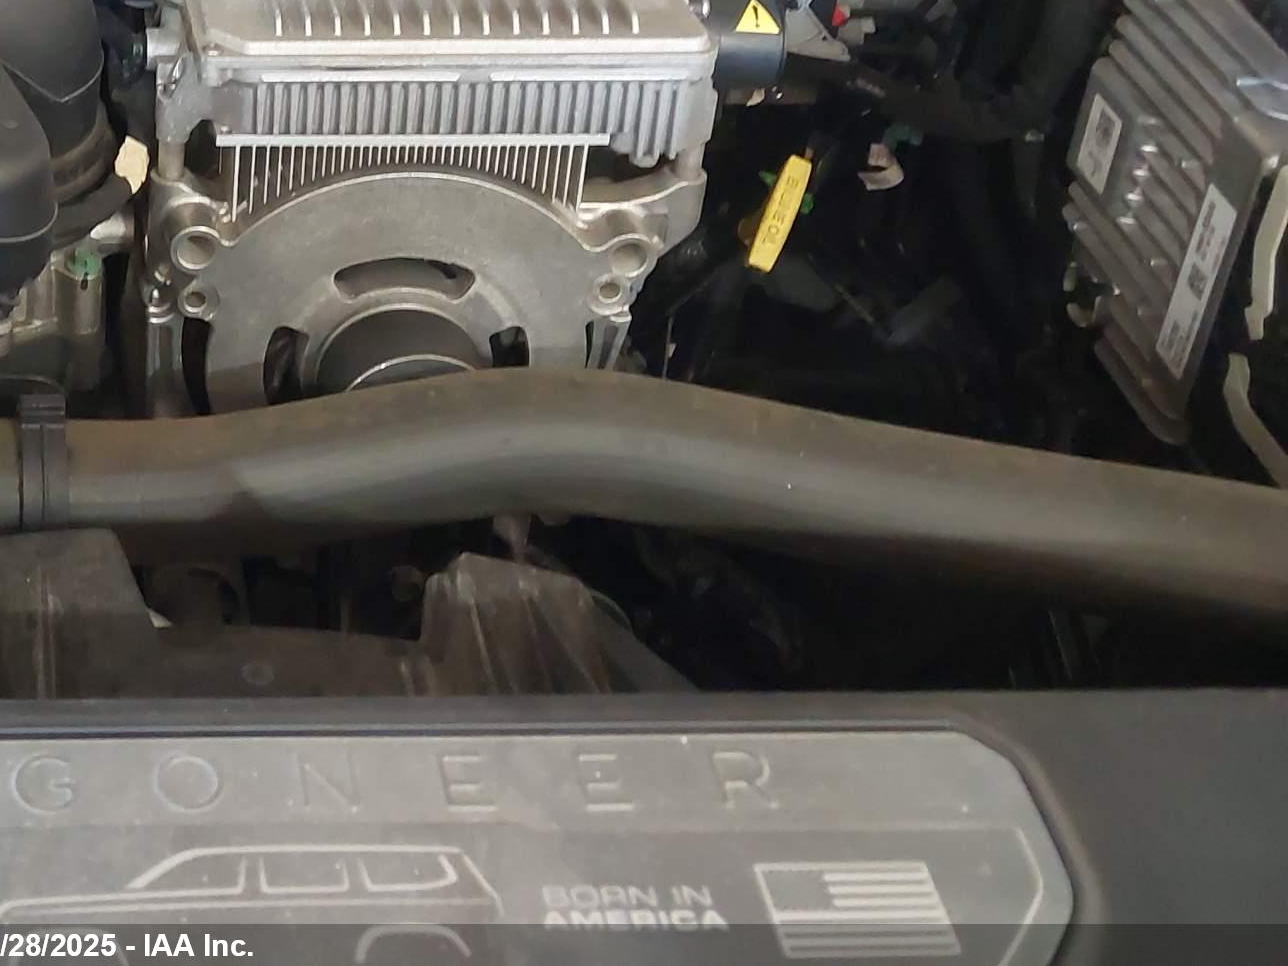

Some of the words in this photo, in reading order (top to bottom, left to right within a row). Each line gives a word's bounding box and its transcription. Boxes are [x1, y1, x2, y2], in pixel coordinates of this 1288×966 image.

[541, 884, 659, 908] BORN
[670, 884, 713, 907] IN
[543, 909, 730, 932] AMERICA
